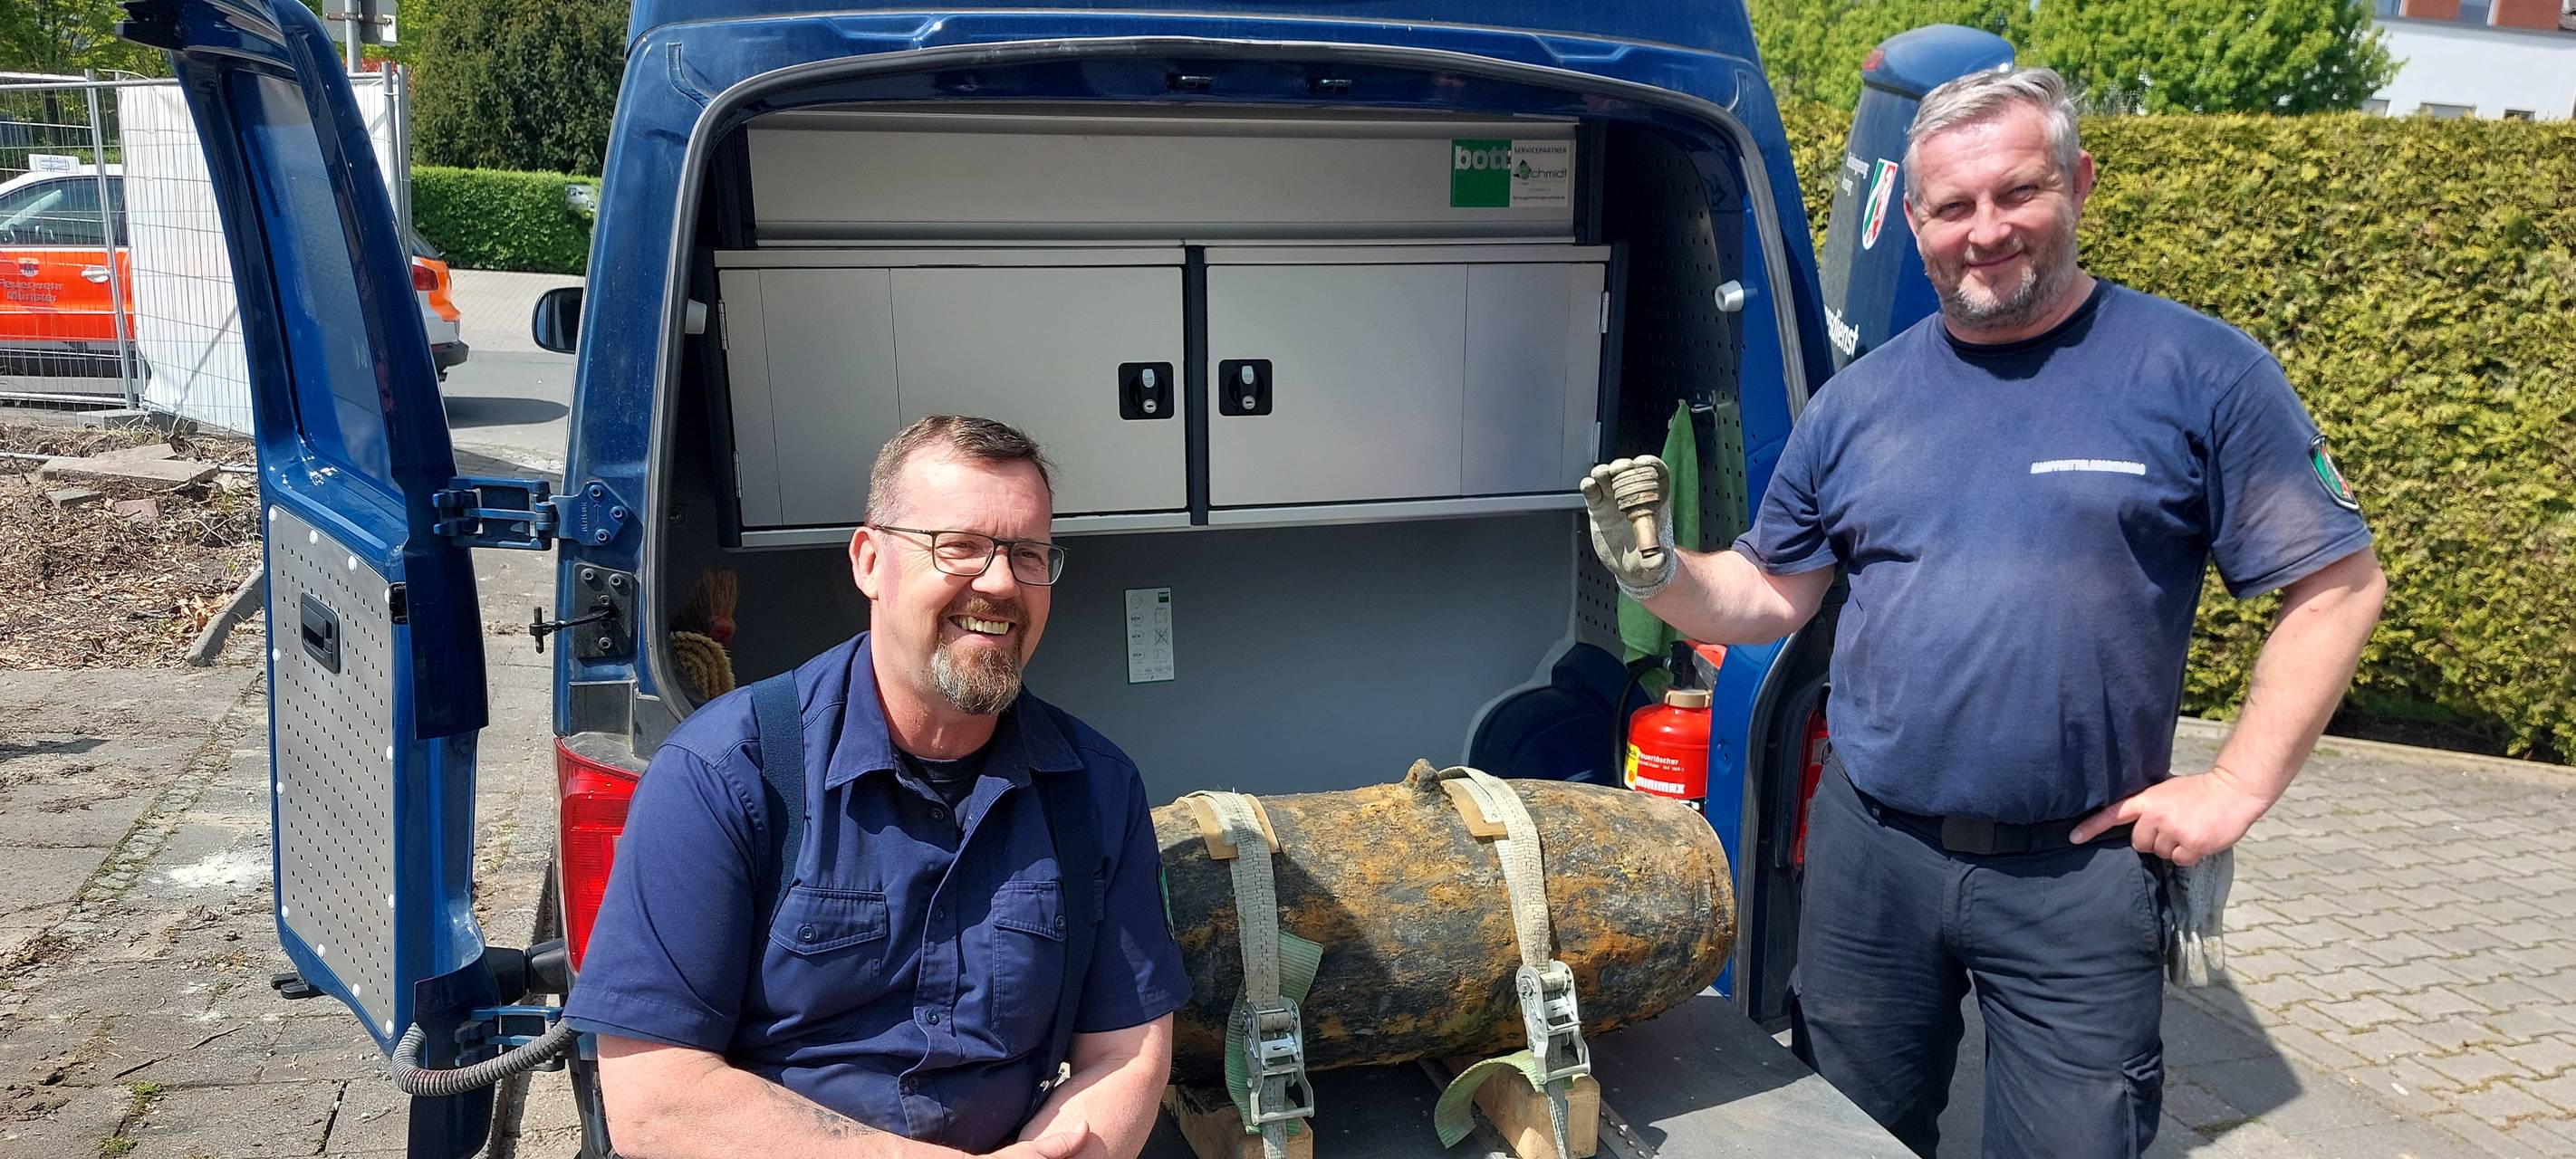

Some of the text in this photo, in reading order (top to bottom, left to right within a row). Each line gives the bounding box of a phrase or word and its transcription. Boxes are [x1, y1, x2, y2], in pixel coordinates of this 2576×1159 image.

[1455, 145, 1511, 170] bott
[1514, 147, 1567, 155] SERVICEPARTNER
[1636, 775, 1686, 794] minimax
